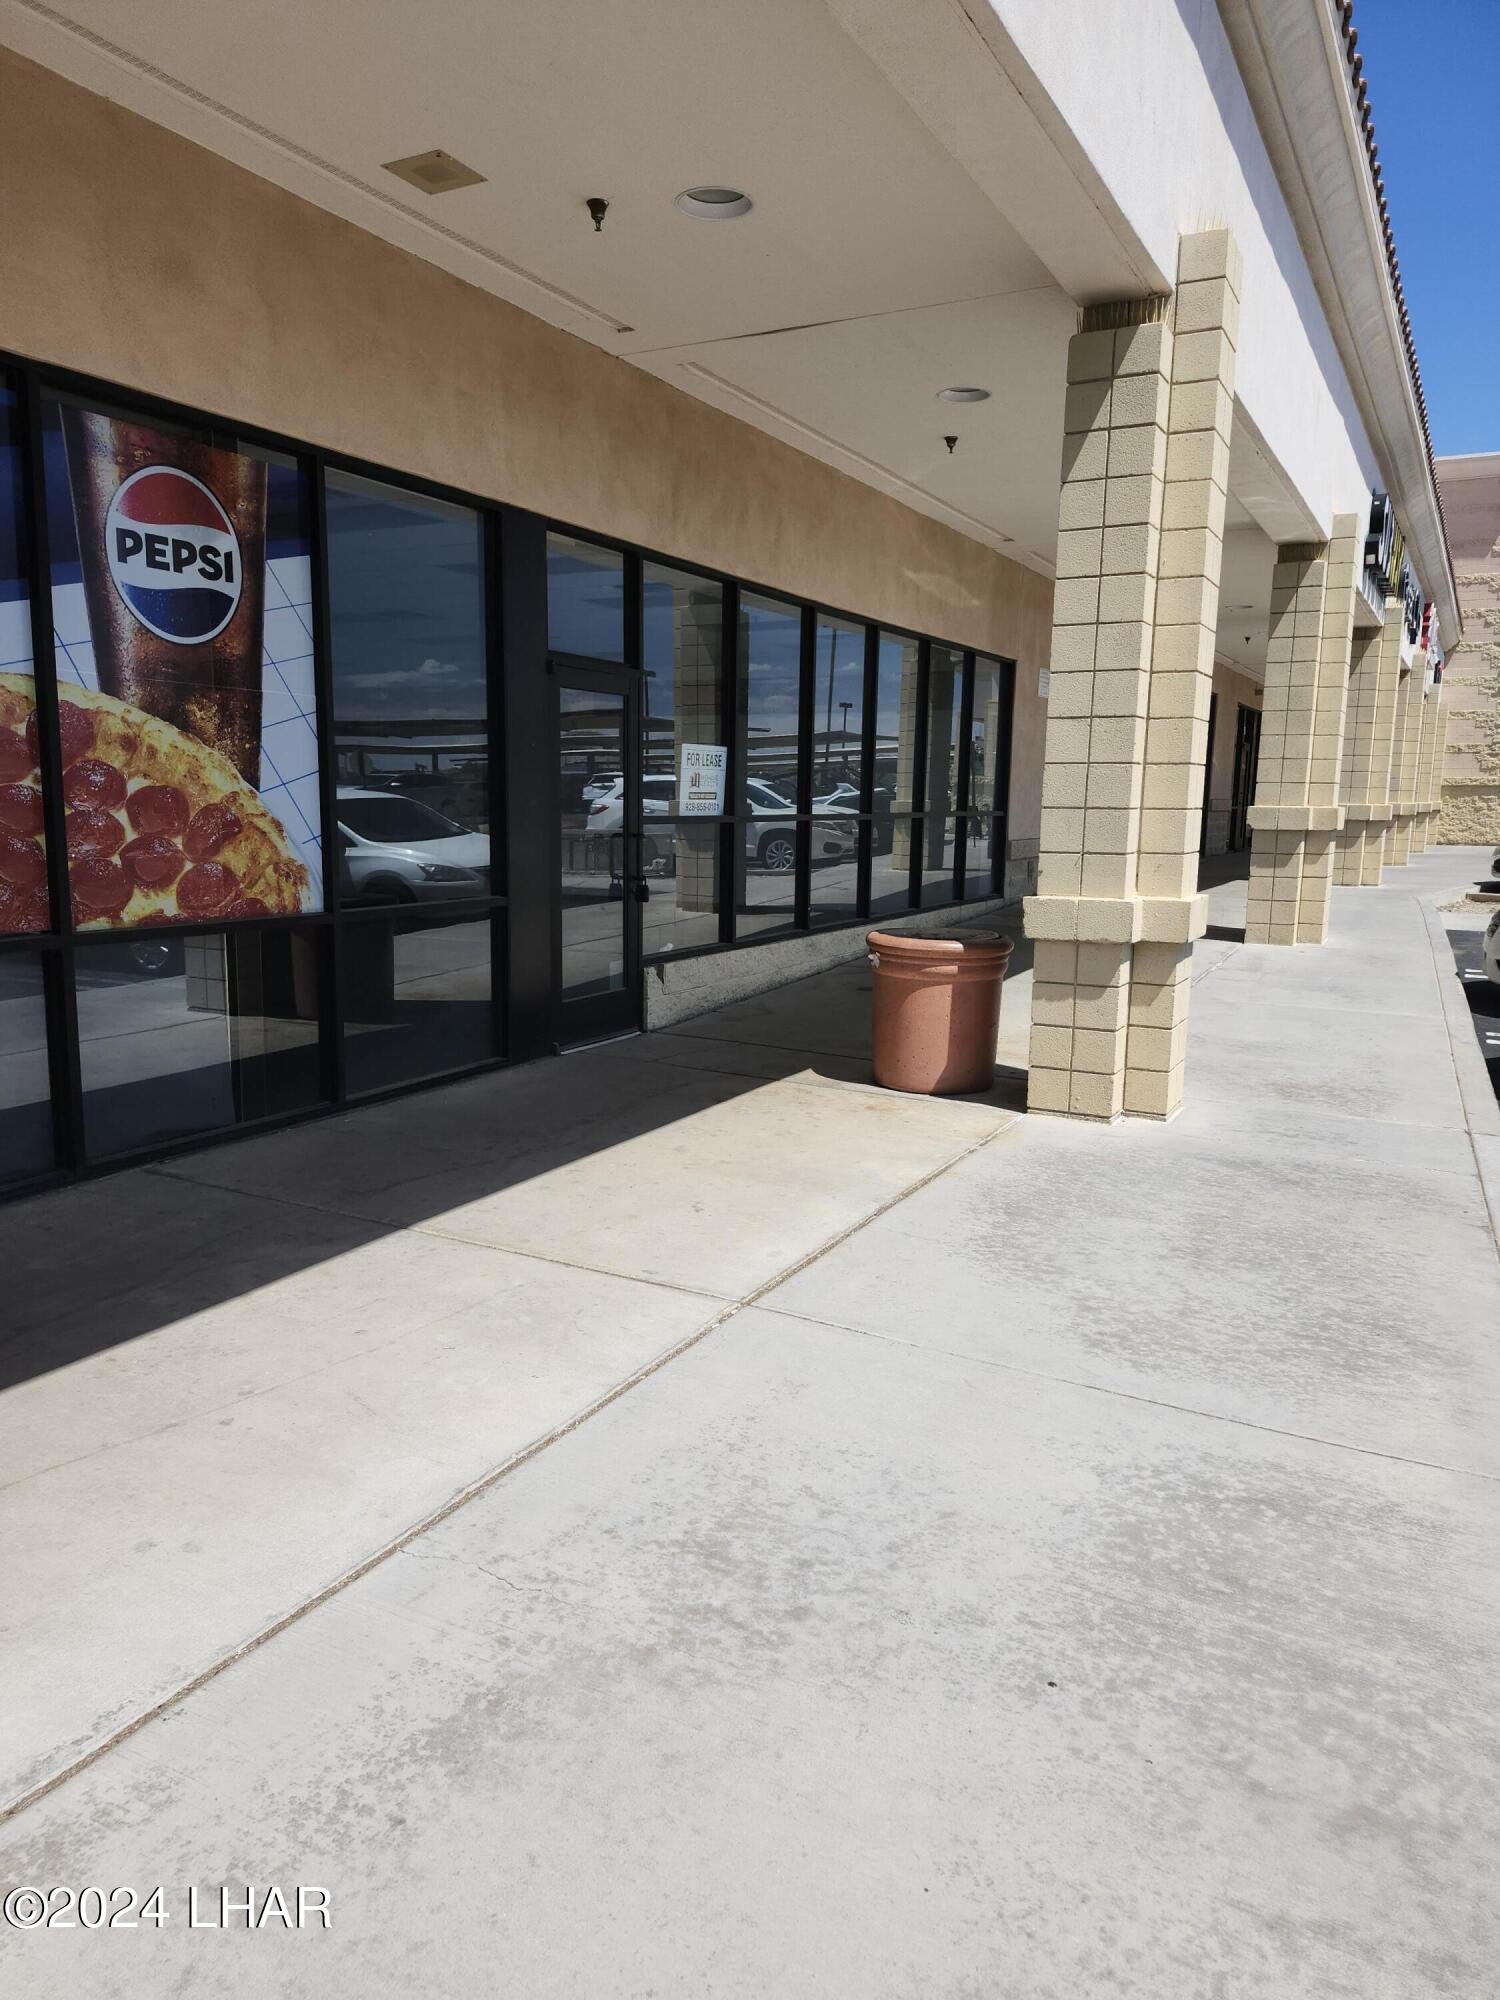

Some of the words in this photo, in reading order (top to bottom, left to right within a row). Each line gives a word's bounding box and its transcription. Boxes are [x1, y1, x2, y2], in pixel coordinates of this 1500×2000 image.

[115, 527, 234, 584] PEPSI
[687, 752, 700, 767] FOR
[702, 753, 722, 767] LEASE
